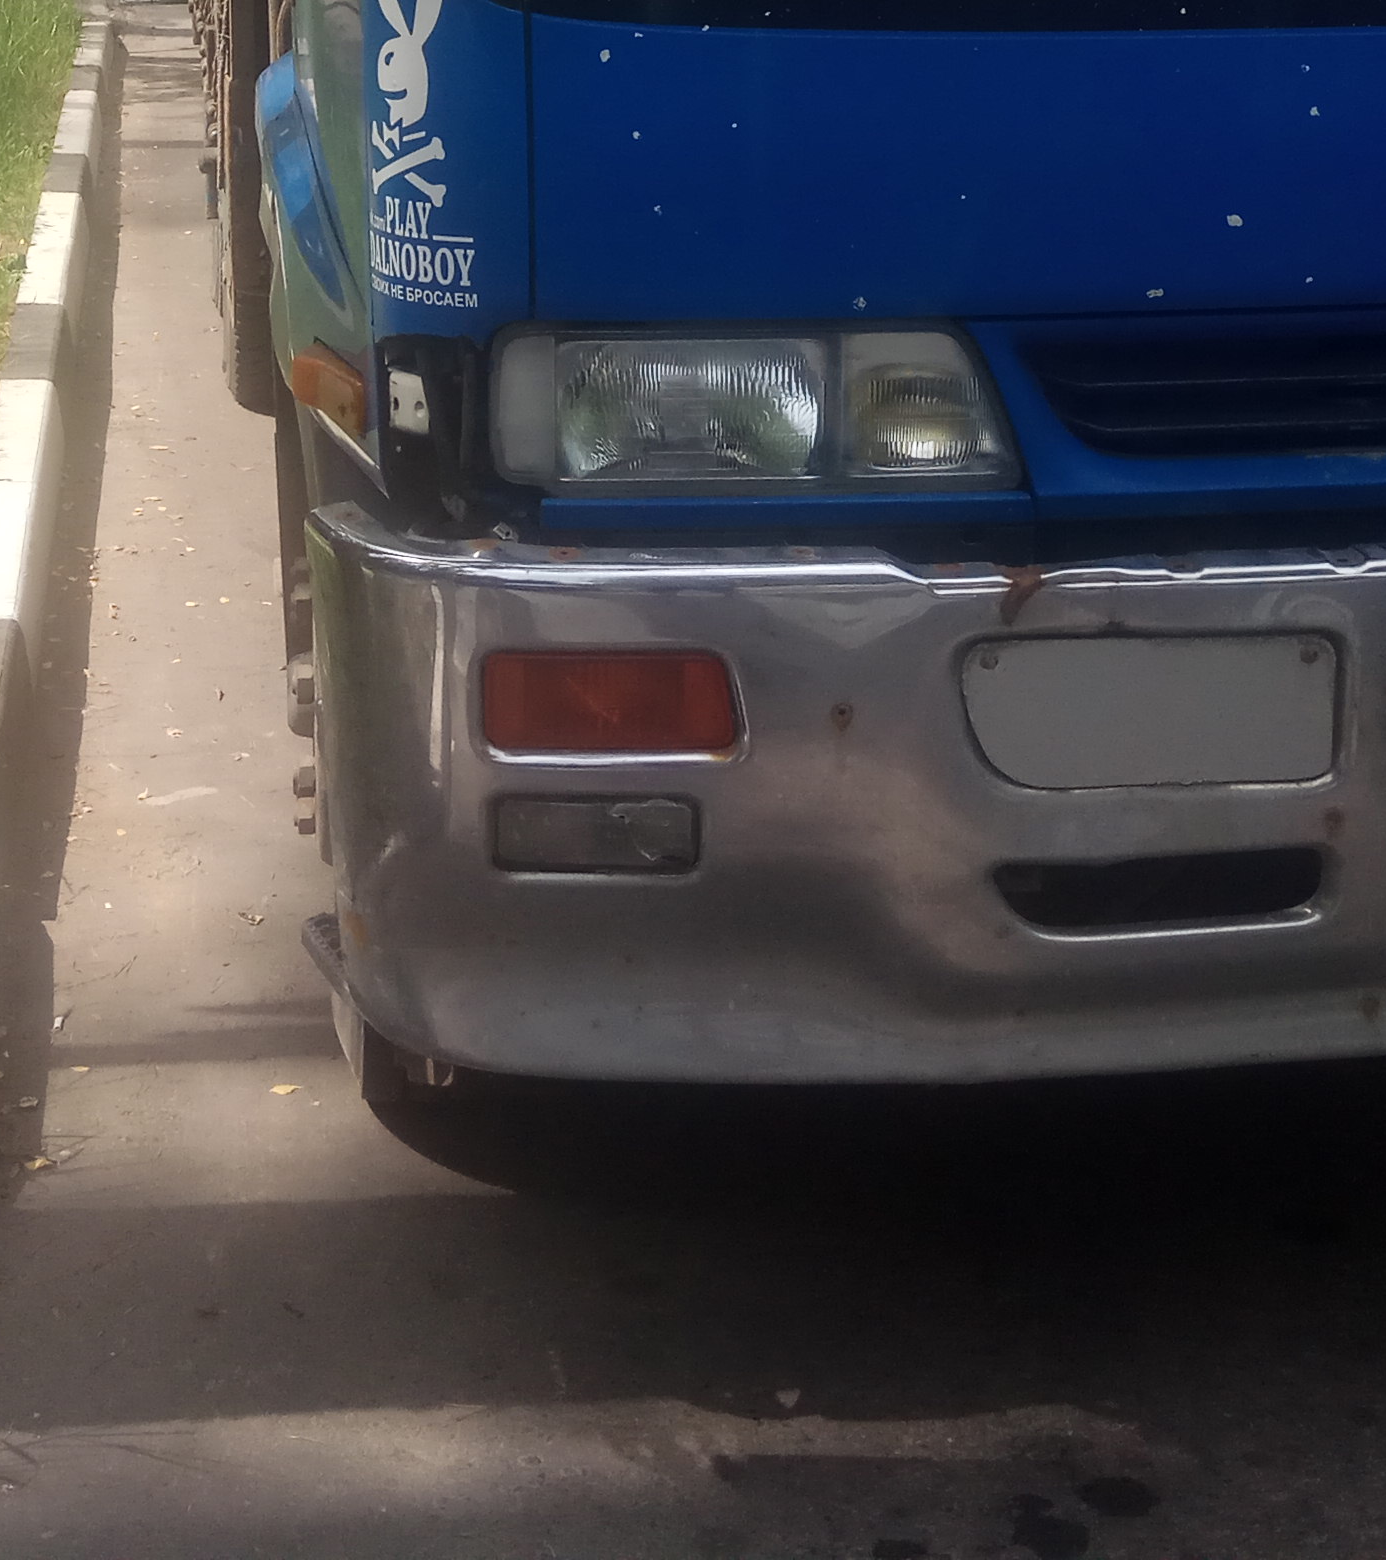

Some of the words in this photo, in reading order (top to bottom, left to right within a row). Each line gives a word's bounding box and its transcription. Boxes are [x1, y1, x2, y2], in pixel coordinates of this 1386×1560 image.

[369, 229, 475, 287] DALNOBOY
[390, 283, 405, 300] НЕ
[406, 287, 478, 308] БРОСАЕМ
